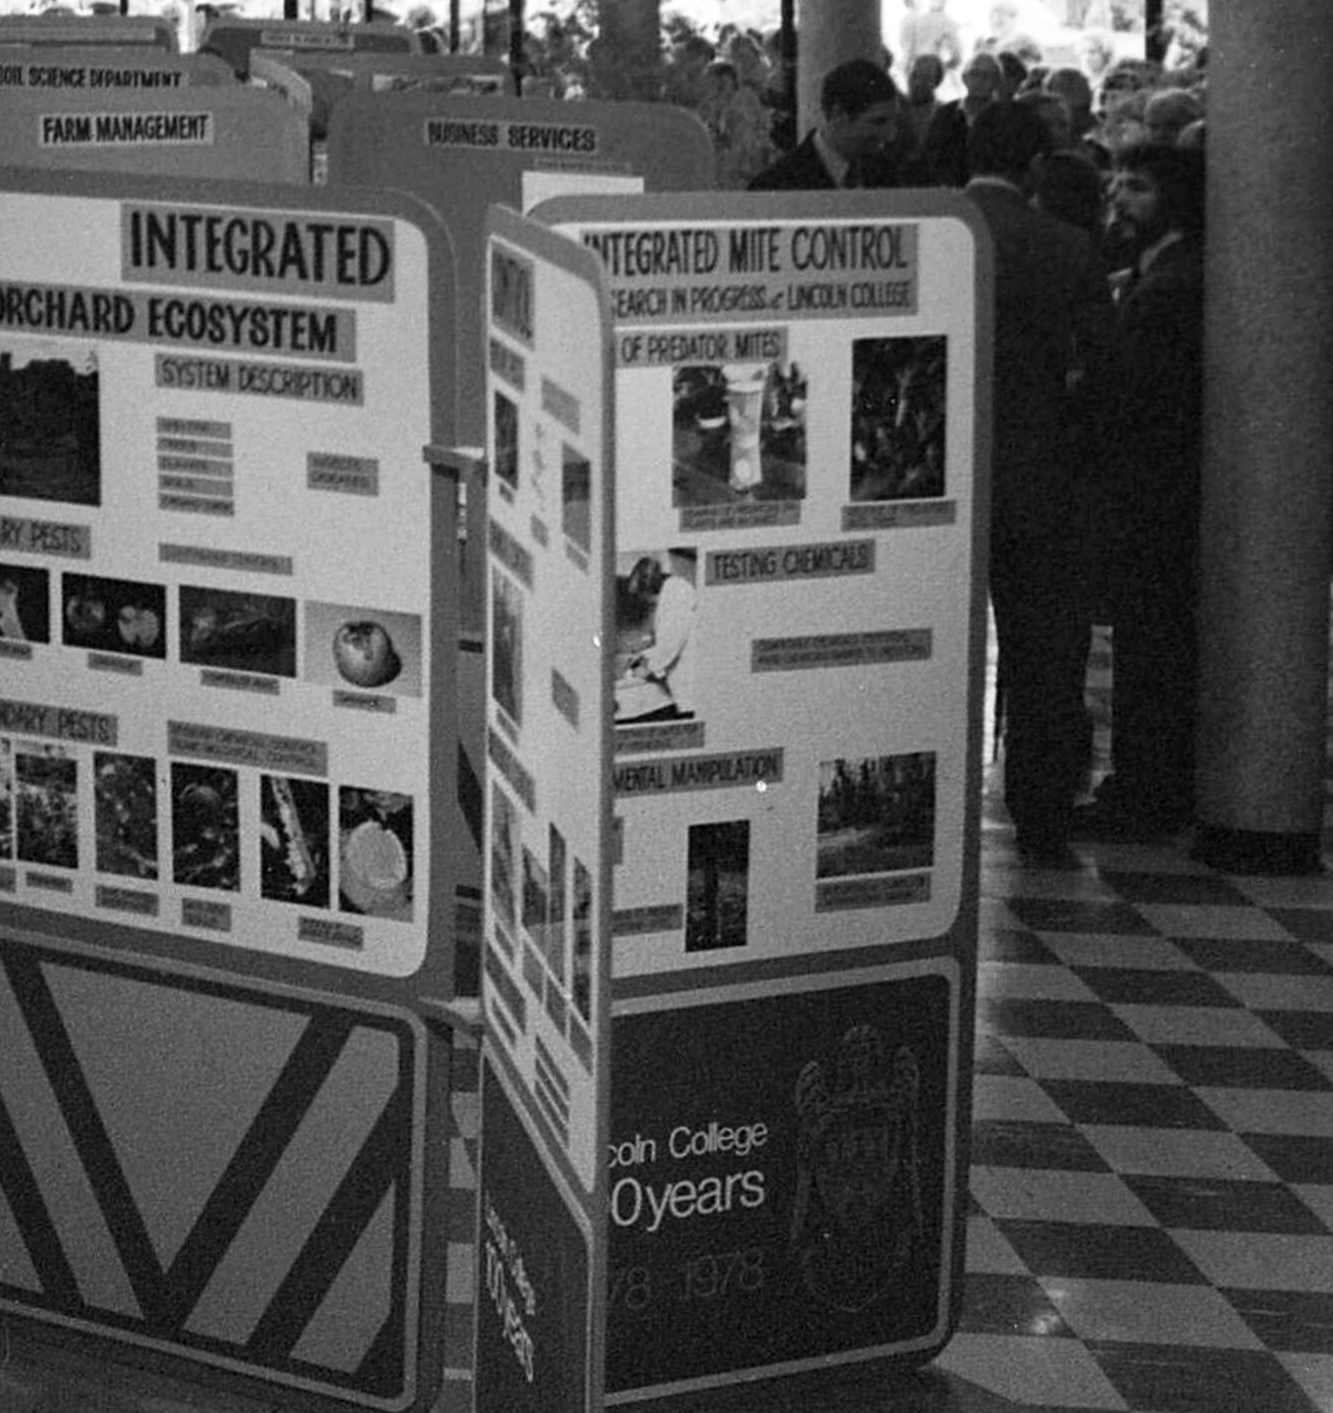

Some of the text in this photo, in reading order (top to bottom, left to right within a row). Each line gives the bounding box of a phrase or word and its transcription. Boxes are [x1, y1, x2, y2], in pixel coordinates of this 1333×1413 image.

[29, 66, 86, 87] SCIENCE
[90, 68, 182, 88] DEPARTMENT
[43, 115, 209, 144] FARM MANAGEMENT
[428, 121, 597, 152] BUSINESS SERVICES
[131, 211, 392, 287] INTEGRATED
[584, 224, 909, 277] NTEGRATED MITE CONTROL
[611, 286, 667, 319] EARCH
[787, 281, 847, 310] LINCOLN
[851, 278, 912, 308] COLLEGE
[148, 298, 337, 354] ECOSYSTEM
[622, 331, 781, 363] OF PREDATOR MITES
[162, 359, 357, 400] SYSTEM DESCRIPTION
[31, 520, 83, 553] PESTS
[714, 544, 870, 580] TESTING CHEMICALS
[58, 707, 111, 743] PESTS
[671, 754, 780, 788] MANIPULATION
[669, 1120, 769, 1161] College
[611, 1170, 767, 1233] 0years
